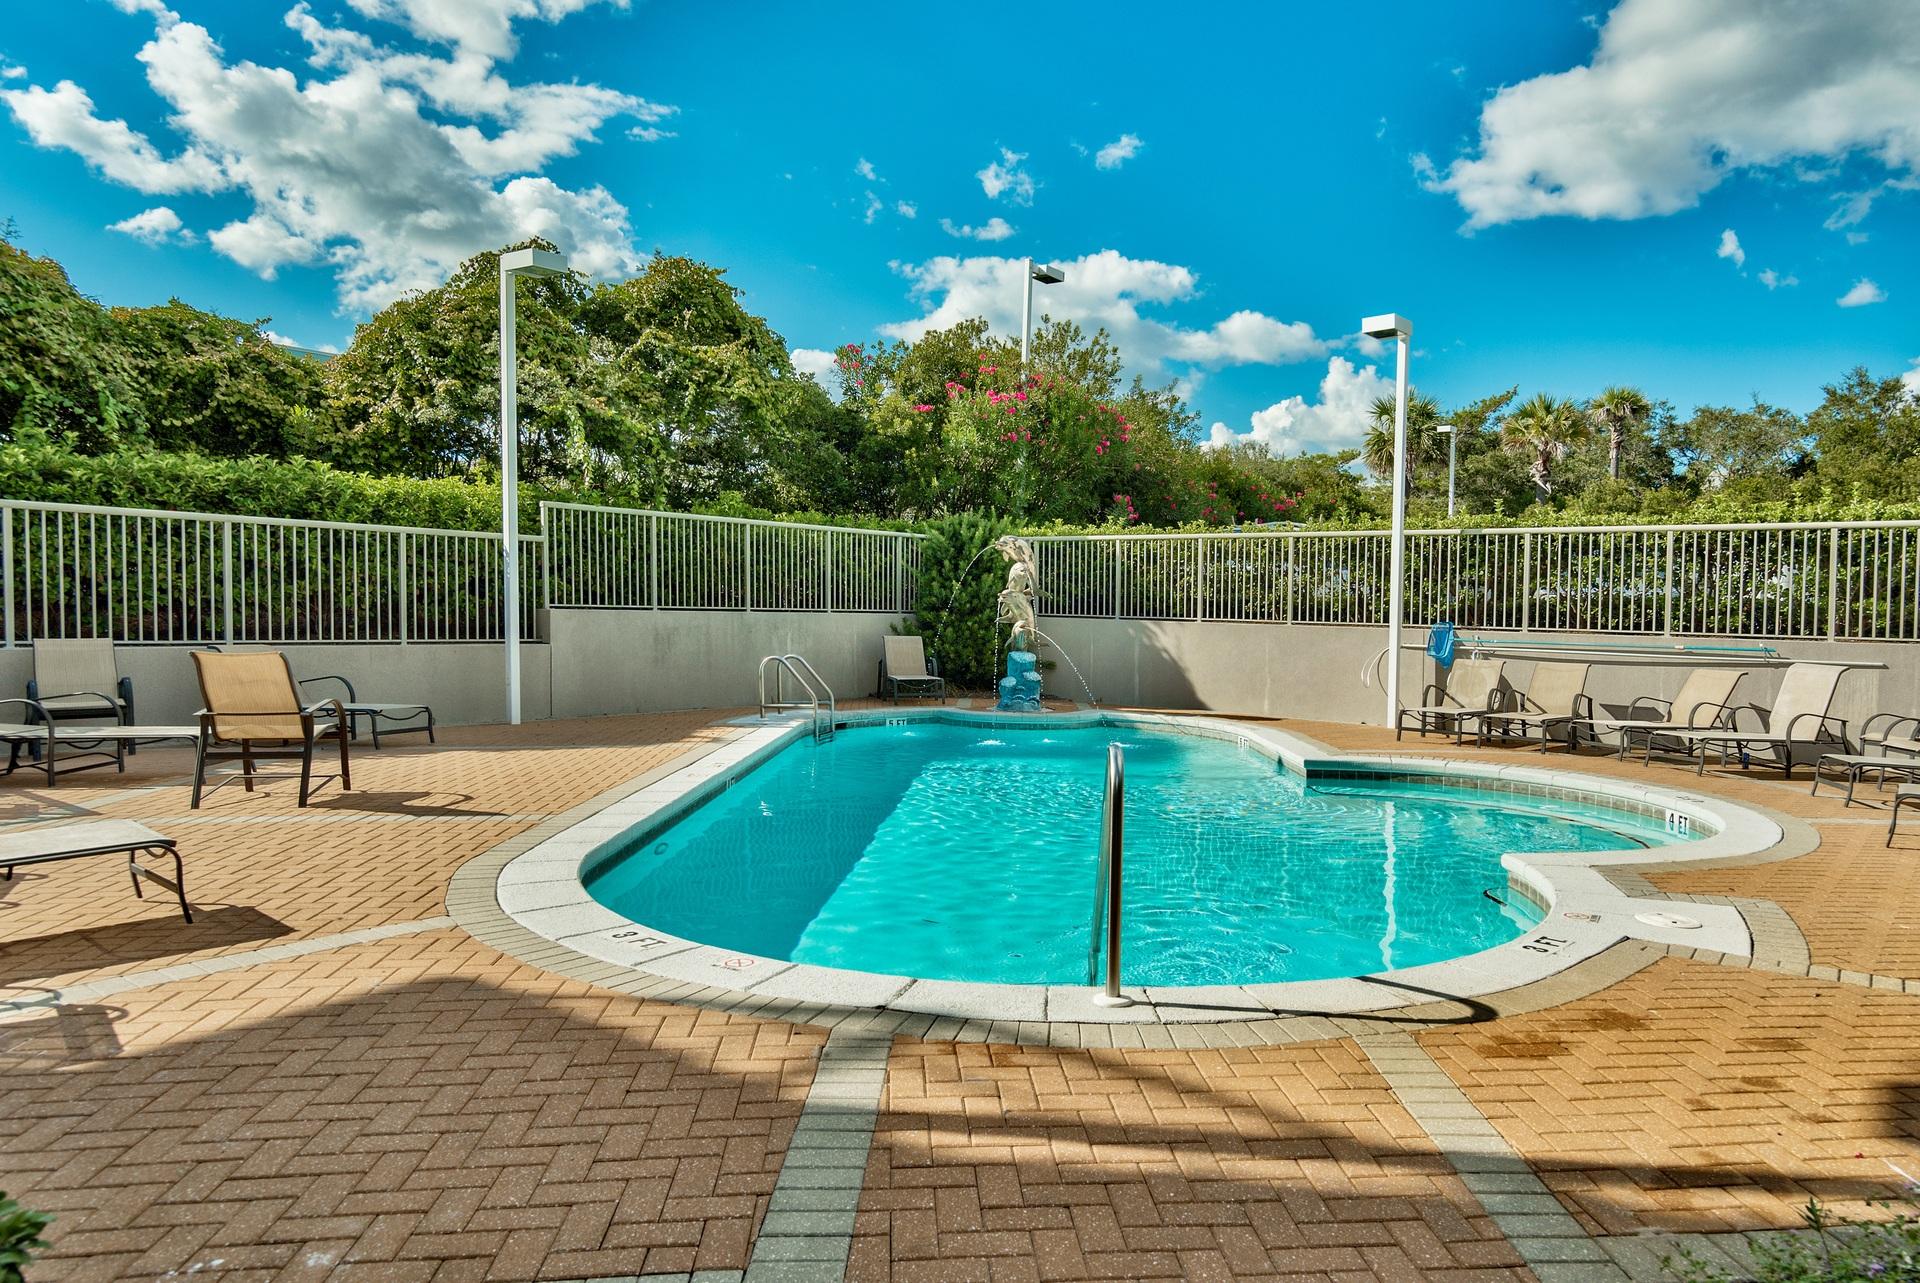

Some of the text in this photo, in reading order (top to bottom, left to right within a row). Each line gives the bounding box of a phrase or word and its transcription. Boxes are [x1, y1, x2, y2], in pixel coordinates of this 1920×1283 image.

[1669, 813, 1674, 827] 4
[627, 937, 668, 948] FT
[1522, 936, 1567, 953] 3 FT
